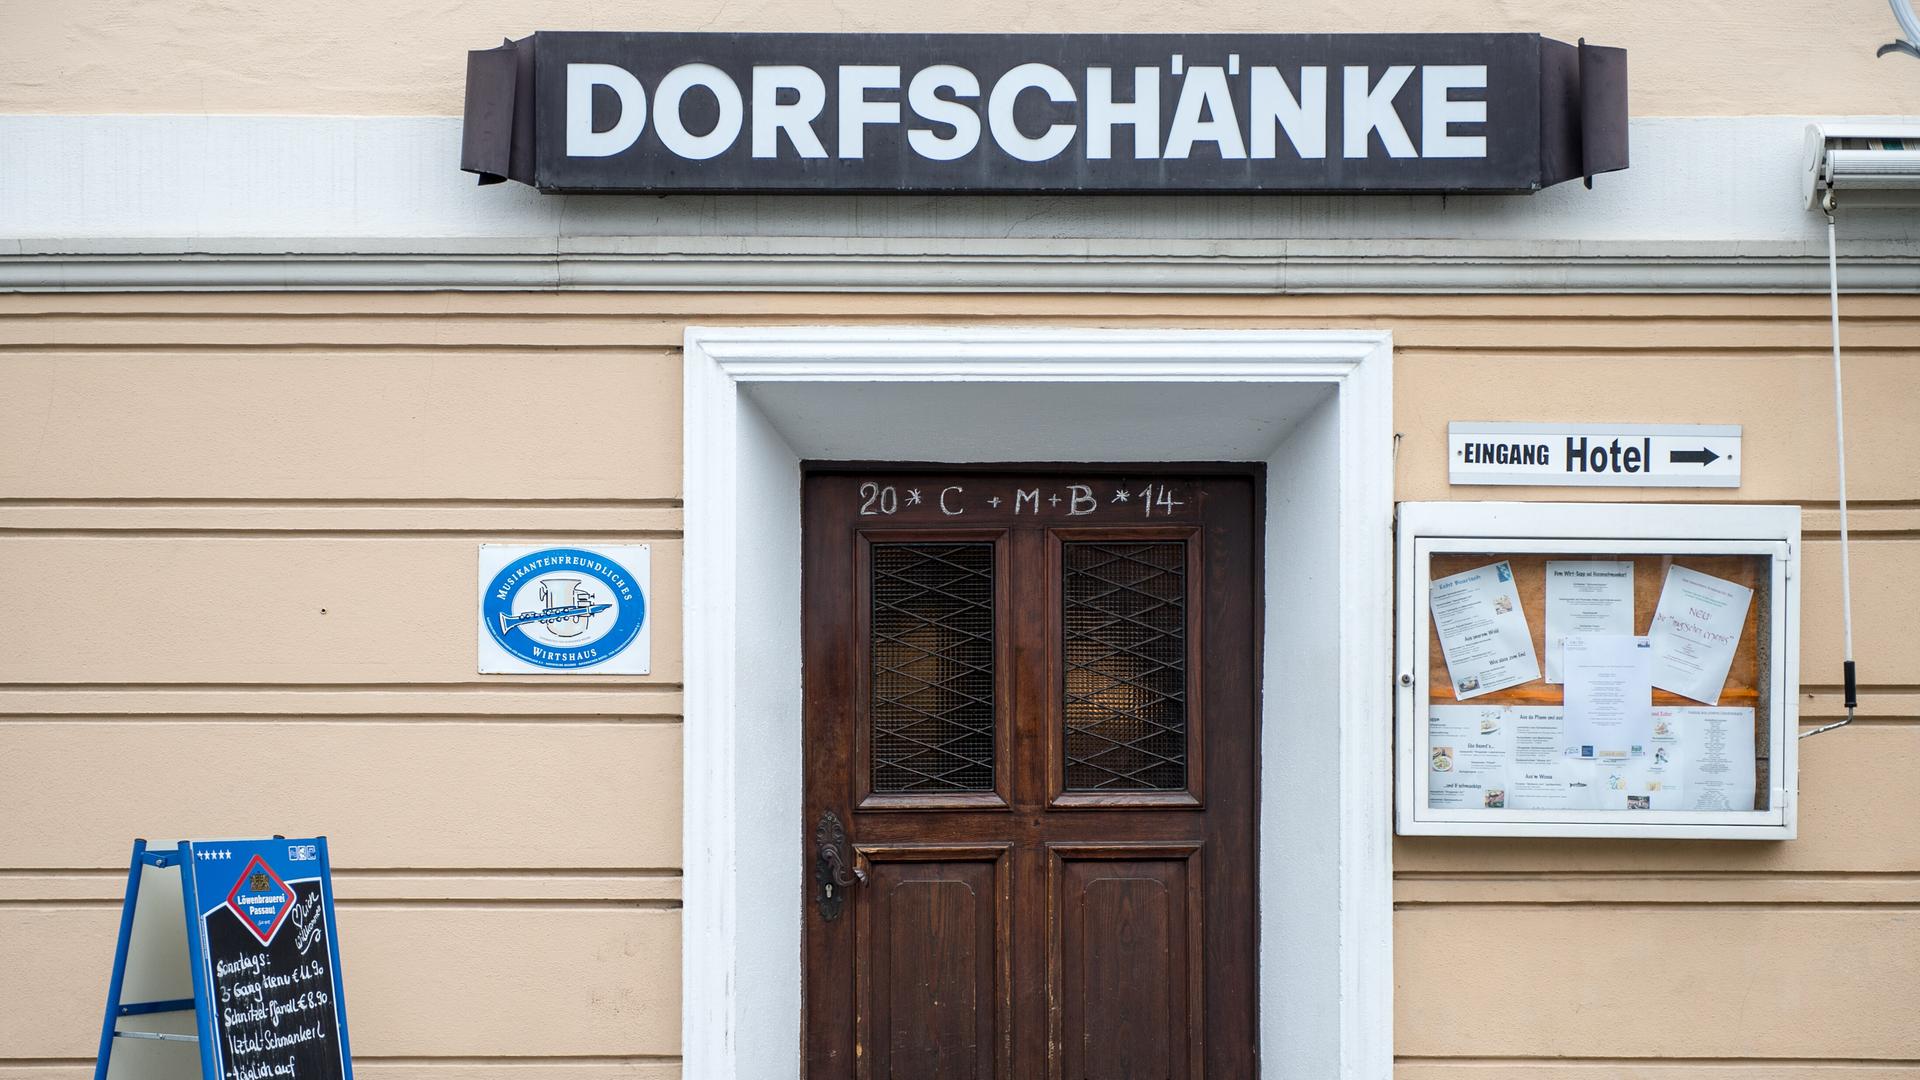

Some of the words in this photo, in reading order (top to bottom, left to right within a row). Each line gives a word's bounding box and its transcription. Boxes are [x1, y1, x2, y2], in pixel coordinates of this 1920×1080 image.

[565, 53, 1489, 162] DORFSCHÄNKE
[1464, 442, 1550, 466] EINGANG
[1566, 437, 1651, 474] Hotel
[496, 556, 634, 602] MUSIKANTENFREUNDLICHES
[532, 646, 598, 662] WIRTSHAUS
[236, 892, 286, 905] Löwenbrauerei
[216, 951, 271, 978] Sonntags:
